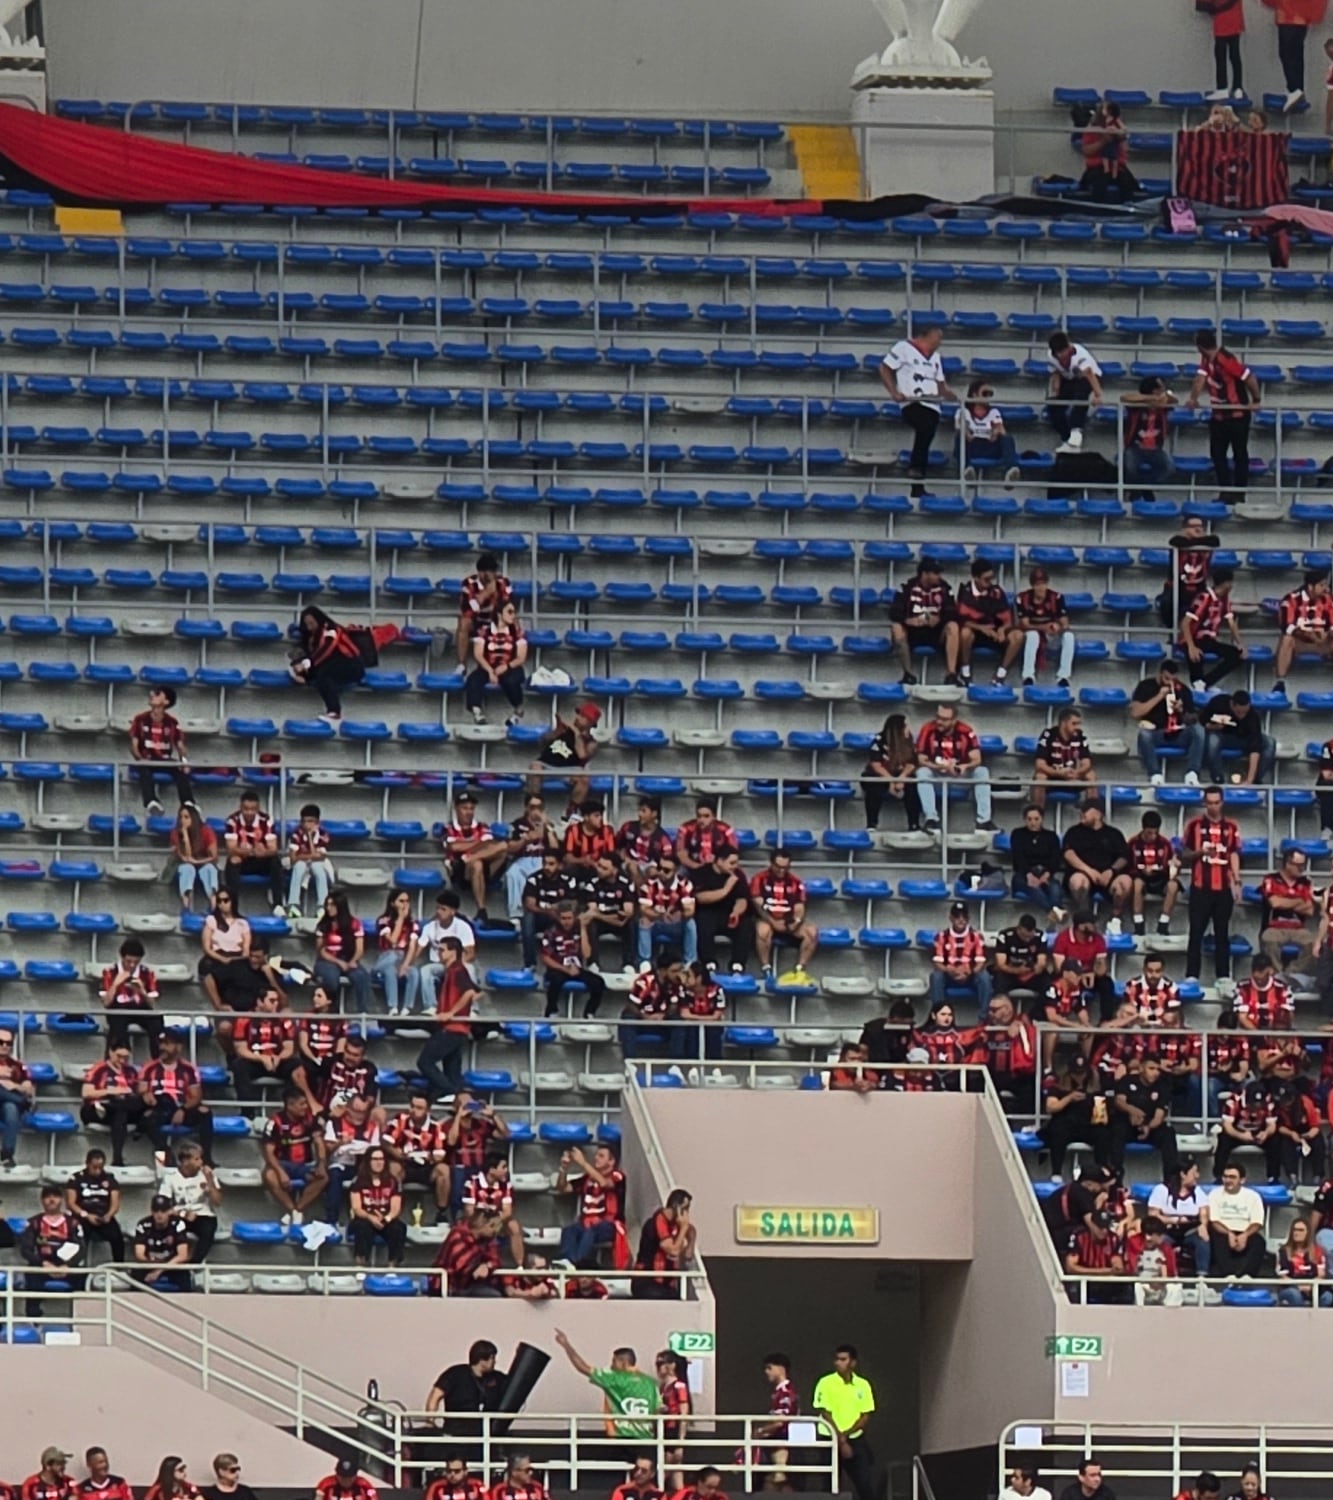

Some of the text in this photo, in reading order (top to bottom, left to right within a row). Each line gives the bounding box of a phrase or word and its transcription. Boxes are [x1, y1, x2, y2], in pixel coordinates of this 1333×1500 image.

[760, 1212, 855, 1237] SALIDA
[684, 1333, 713, 1350] E22
[1071, 1339, 1098, 1355] E22
